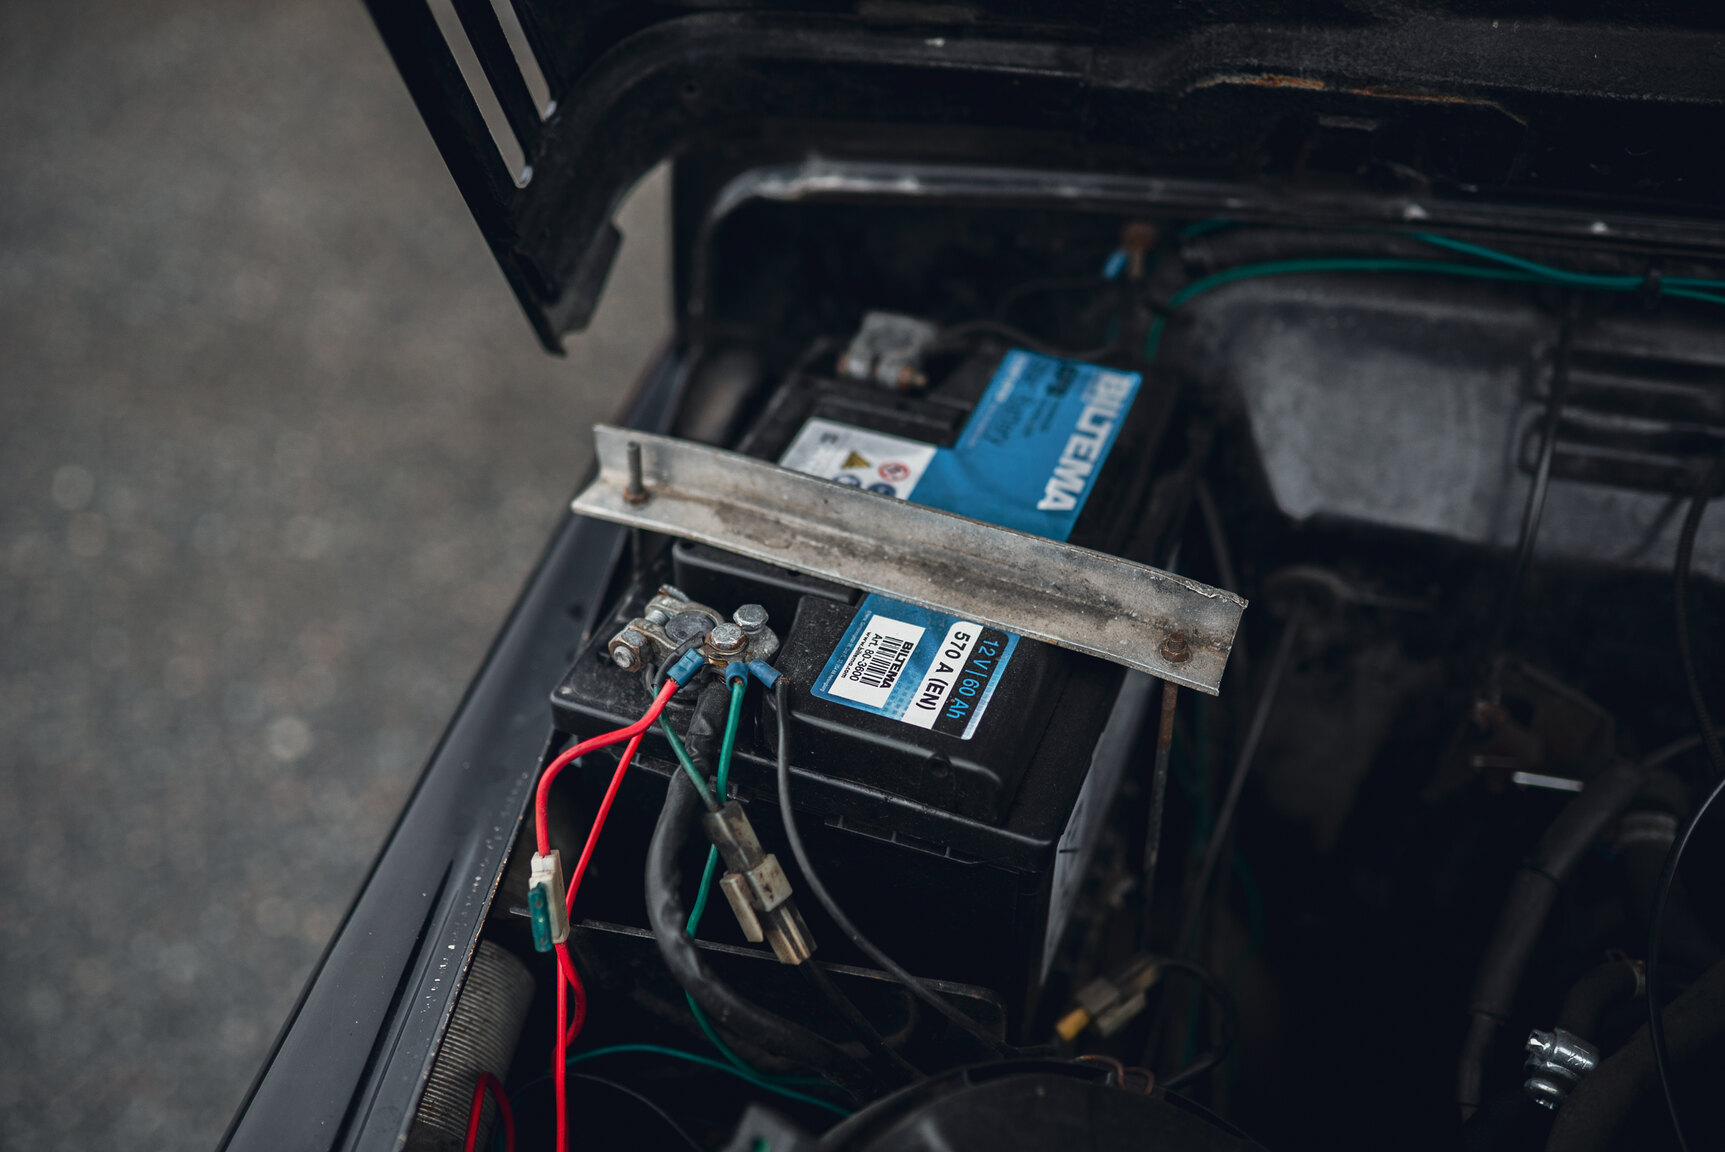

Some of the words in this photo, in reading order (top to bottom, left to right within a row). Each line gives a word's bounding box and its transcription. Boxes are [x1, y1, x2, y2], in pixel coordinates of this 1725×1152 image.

[1036, 371, 1133, 511] BILTEMA
[868, 633, 883, 647] Art.
[944, 631, 971, 660] 570
[978, 639, 999, 657] 12
[841, 631, 872, 679] www.biltema.com
[849, 649, 875, 682] 80-3600
[879, 641, 915, 689] BILTEMA
[935, 661, 954, 674] A
[973, 659, 991, 670] V
[915, 678, 949, 710] (EN)
[958, 678, 980, 697] 60
[946, 697, 970, 719] Ah
